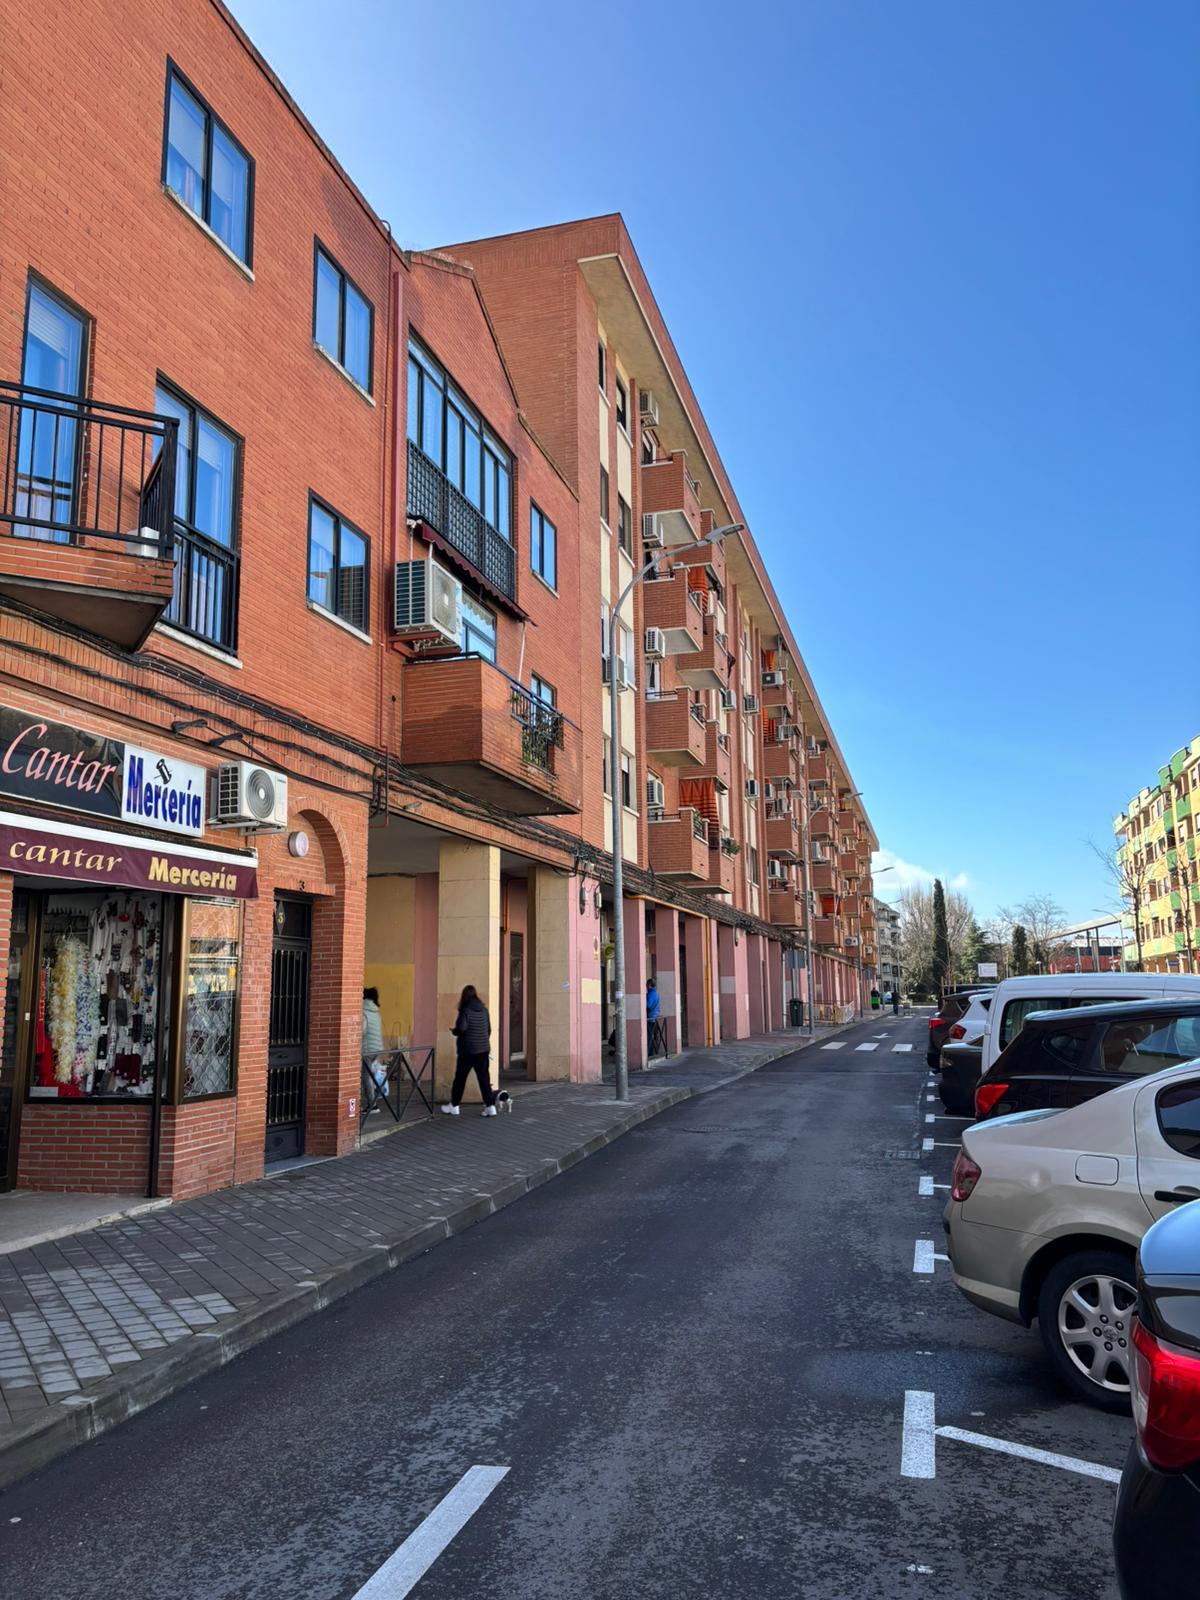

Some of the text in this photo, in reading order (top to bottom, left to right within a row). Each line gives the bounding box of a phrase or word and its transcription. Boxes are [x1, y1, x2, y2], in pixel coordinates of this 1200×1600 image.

[2, 724, 117, 794] Cantar
[126, 755, 202, 829] Mercería
[9, 841, 122, 872] cantar
[149, 857, 237, 891] Mercería
